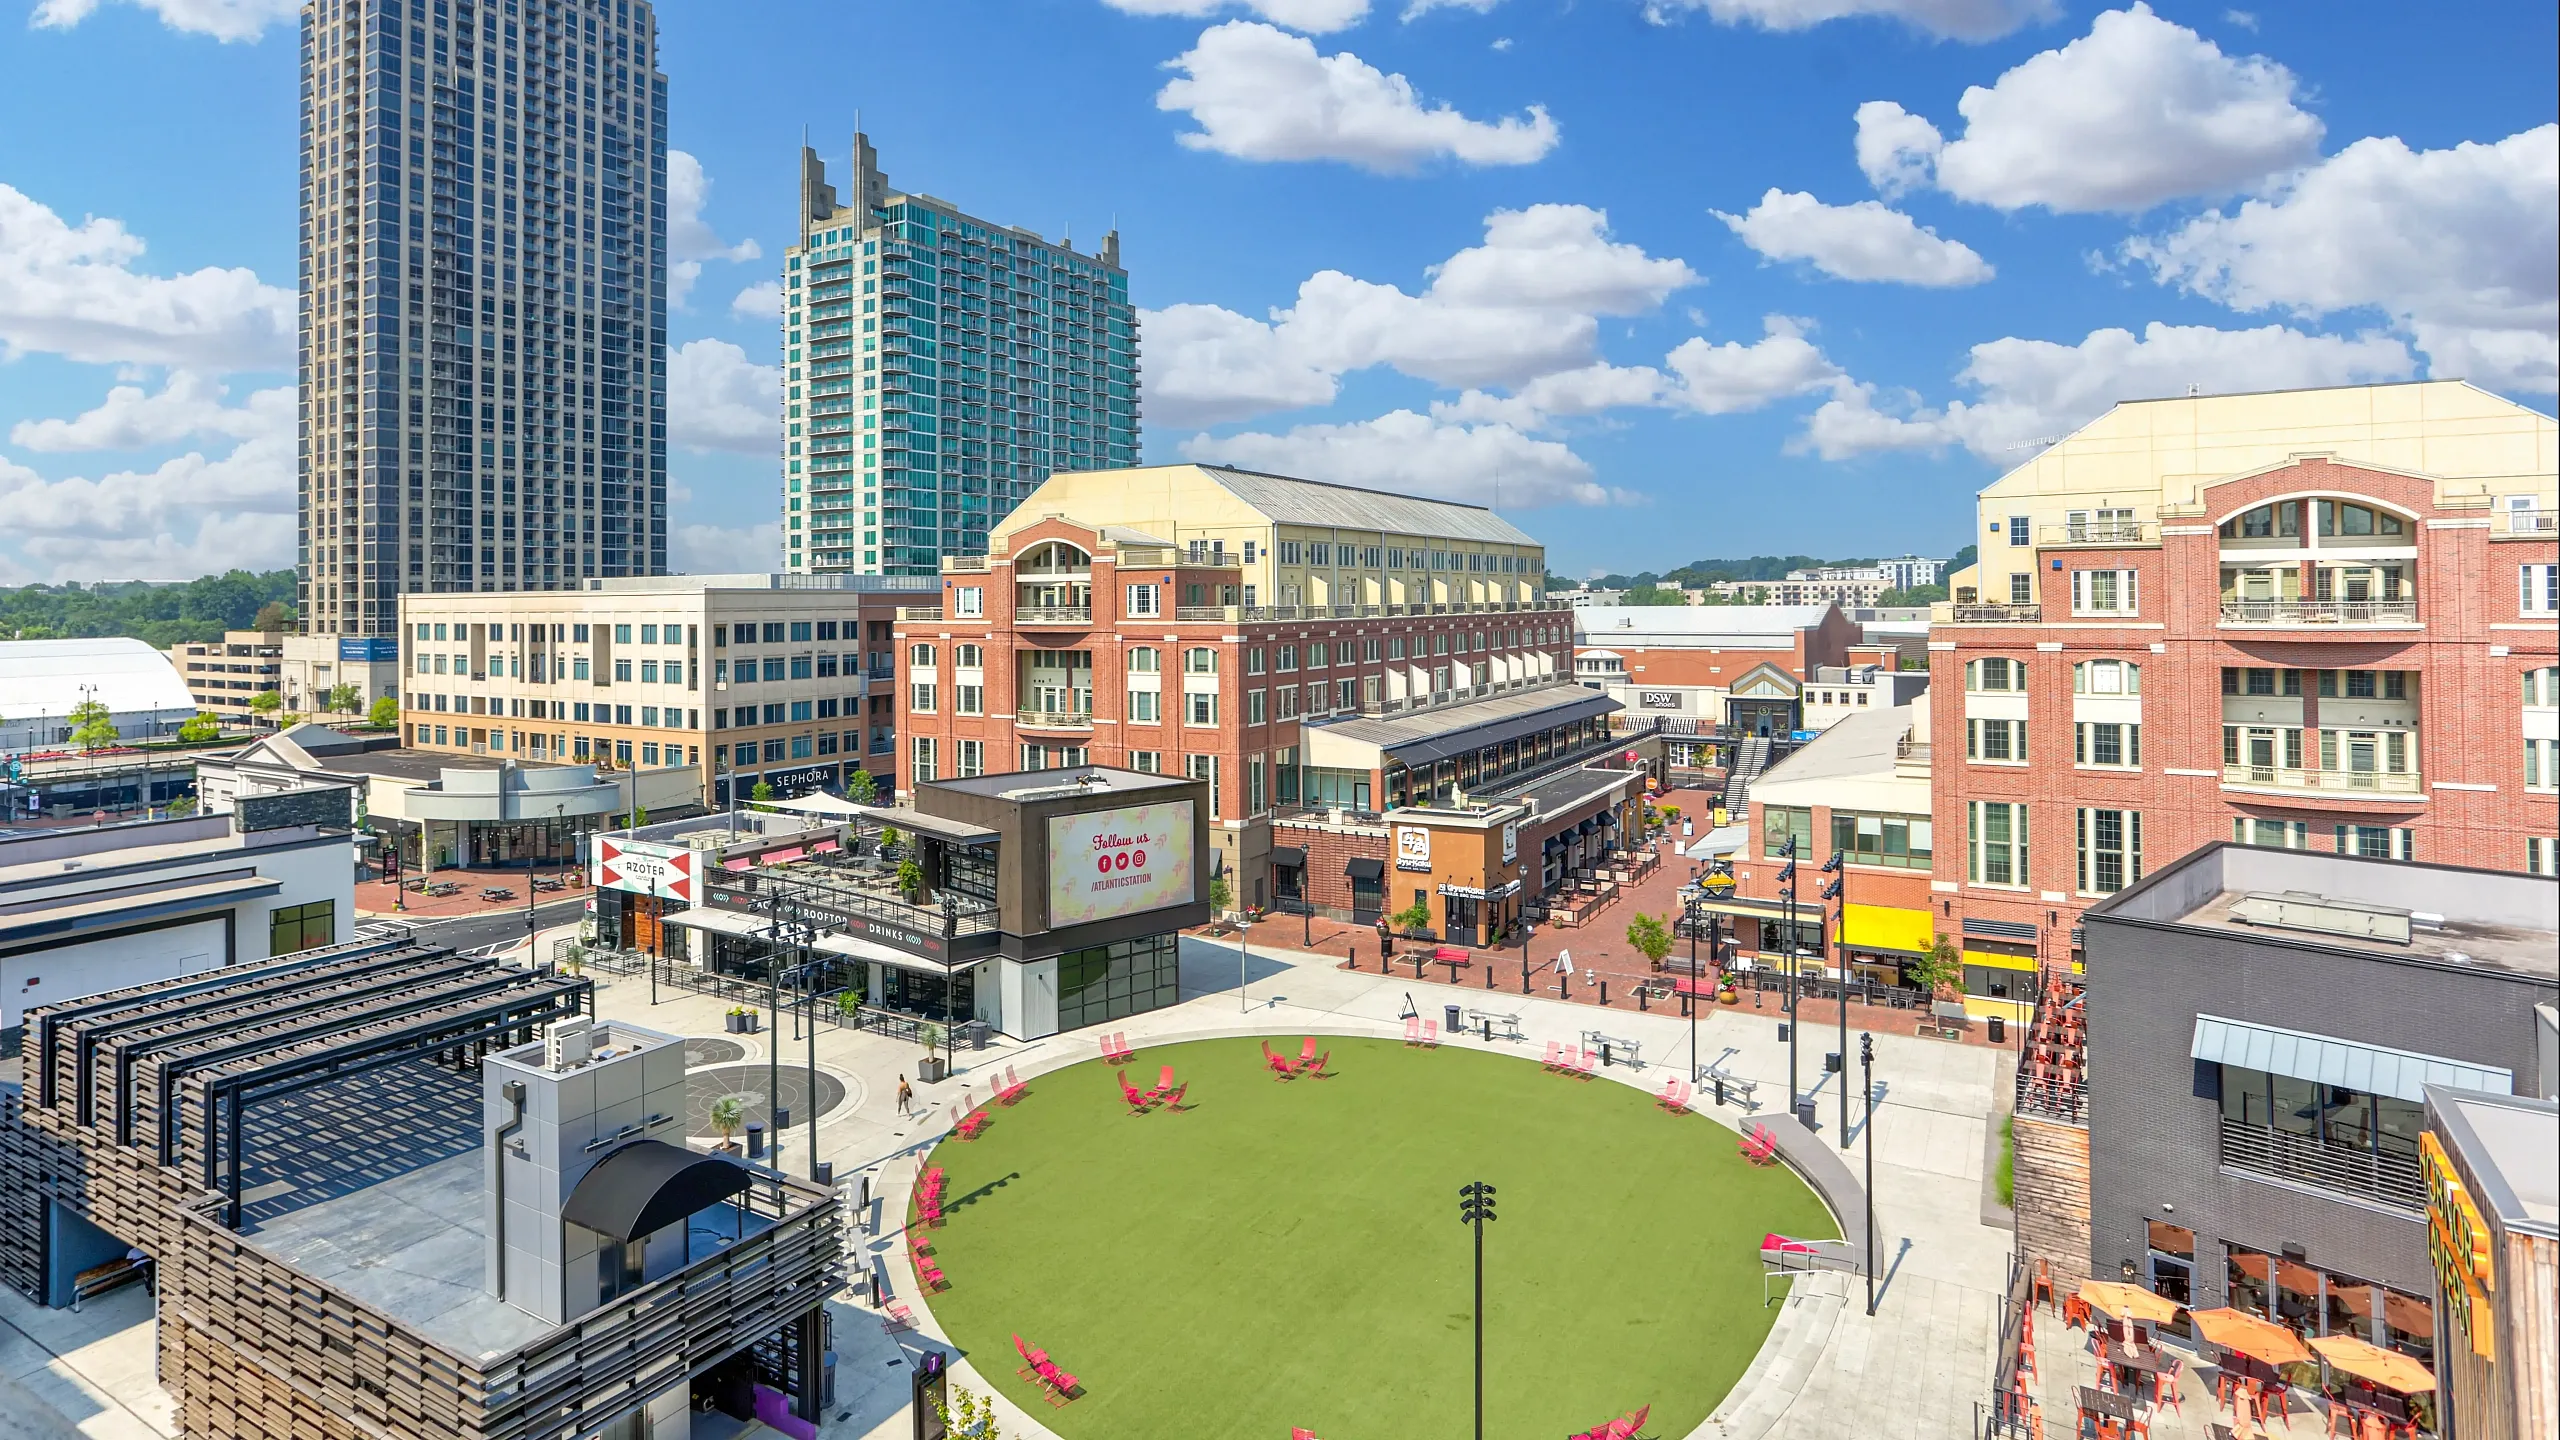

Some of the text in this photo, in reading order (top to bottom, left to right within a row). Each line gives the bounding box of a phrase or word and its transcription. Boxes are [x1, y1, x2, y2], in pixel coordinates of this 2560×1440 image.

[1645, 692, 1672, 703] DSW
[776, 770, 829, 787] SEPHORA
[1092, 833, 1151, 850] Follow us
[626, 861, 665, 876] AZOTEA
[1090, 873, 1152, 893] /ATLANTICSTATION
[868, 923, 903, 941] DRINKS
[2418, 1134, 2475, 1277] HOBNOB
[2423, 1205, 2474, 1352] TAVERN
[930, 1356, 937, 1371] 1
